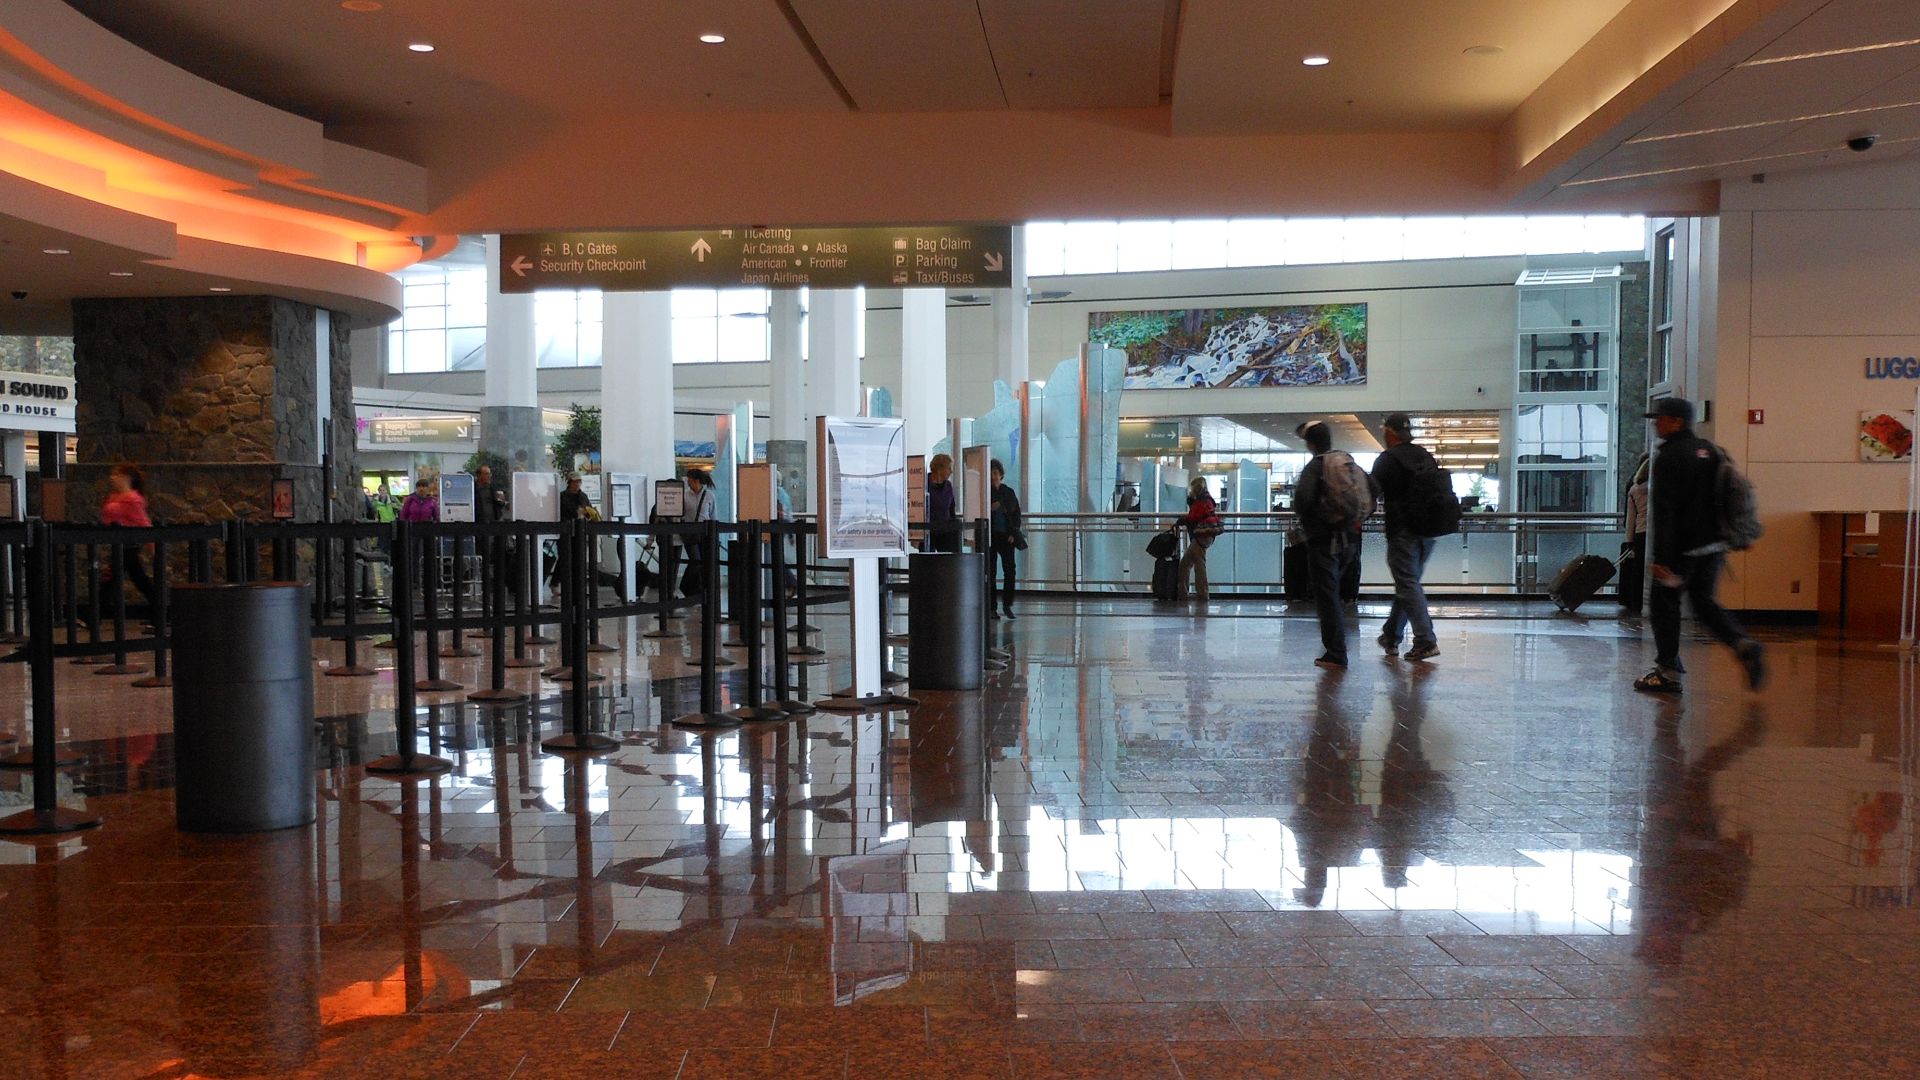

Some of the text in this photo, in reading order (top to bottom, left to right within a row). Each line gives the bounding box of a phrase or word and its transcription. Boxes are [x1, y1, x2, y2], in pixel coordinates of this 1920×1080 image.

[744, 229, 792, 240] Ticketing
[562, 243, 618, 256] B, C Gates
[742, 242, 848, 254] Air Canada Alaska
[916, 238, 972, 253] Bag Claim
[541, 258, 646, 274] Security Checkpoint
[741, 257, 848, 269] American Frontier
[916, 255, 958, 269] Parking
[741, 272, 809, 285] Japan Airlines
[915, 271, 975, 284] Taxi/Buses
[1865, 357, 1920, 379] LUGG
[9, 381, 69, 400] SOUND
[16, 405, 57, 416] HOUSE
